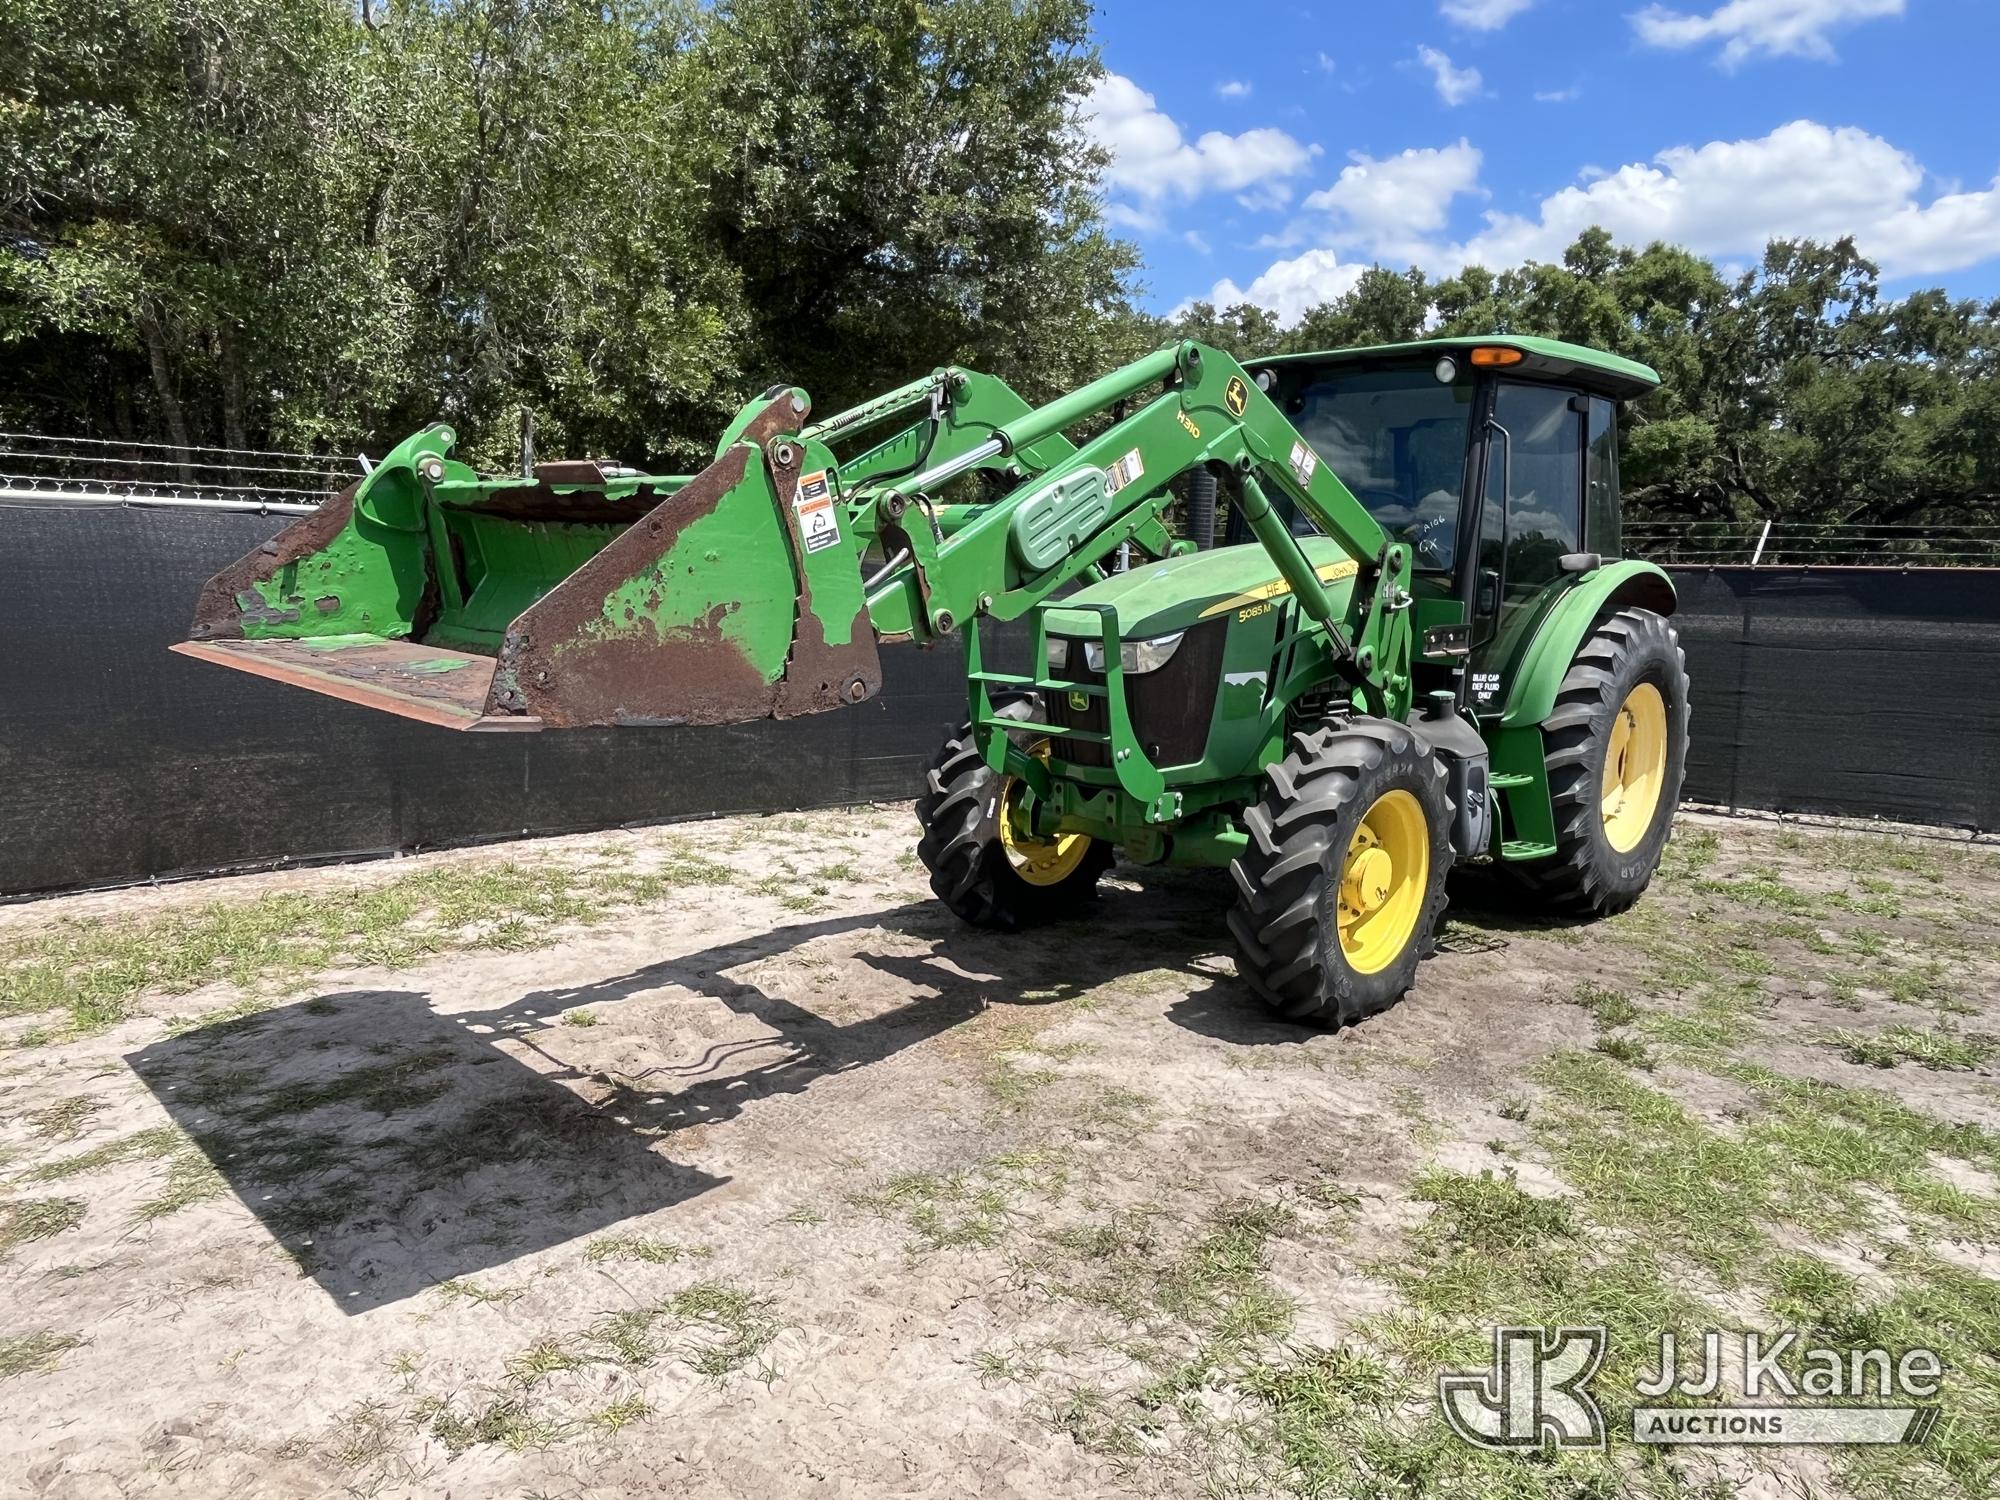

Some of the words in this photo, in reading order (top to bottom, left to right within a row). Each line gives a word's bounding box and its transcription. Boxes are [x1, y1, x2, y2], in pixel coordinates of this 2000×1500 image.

[1423, 514, 1446, 533] A106
[1472, 673, 1487, 682] BLUE
[1487, 673, 1500, 682] CAP
[1484, 682, 1500, 691] FLUID
[1477, 691, 1492, 700] ONLY
